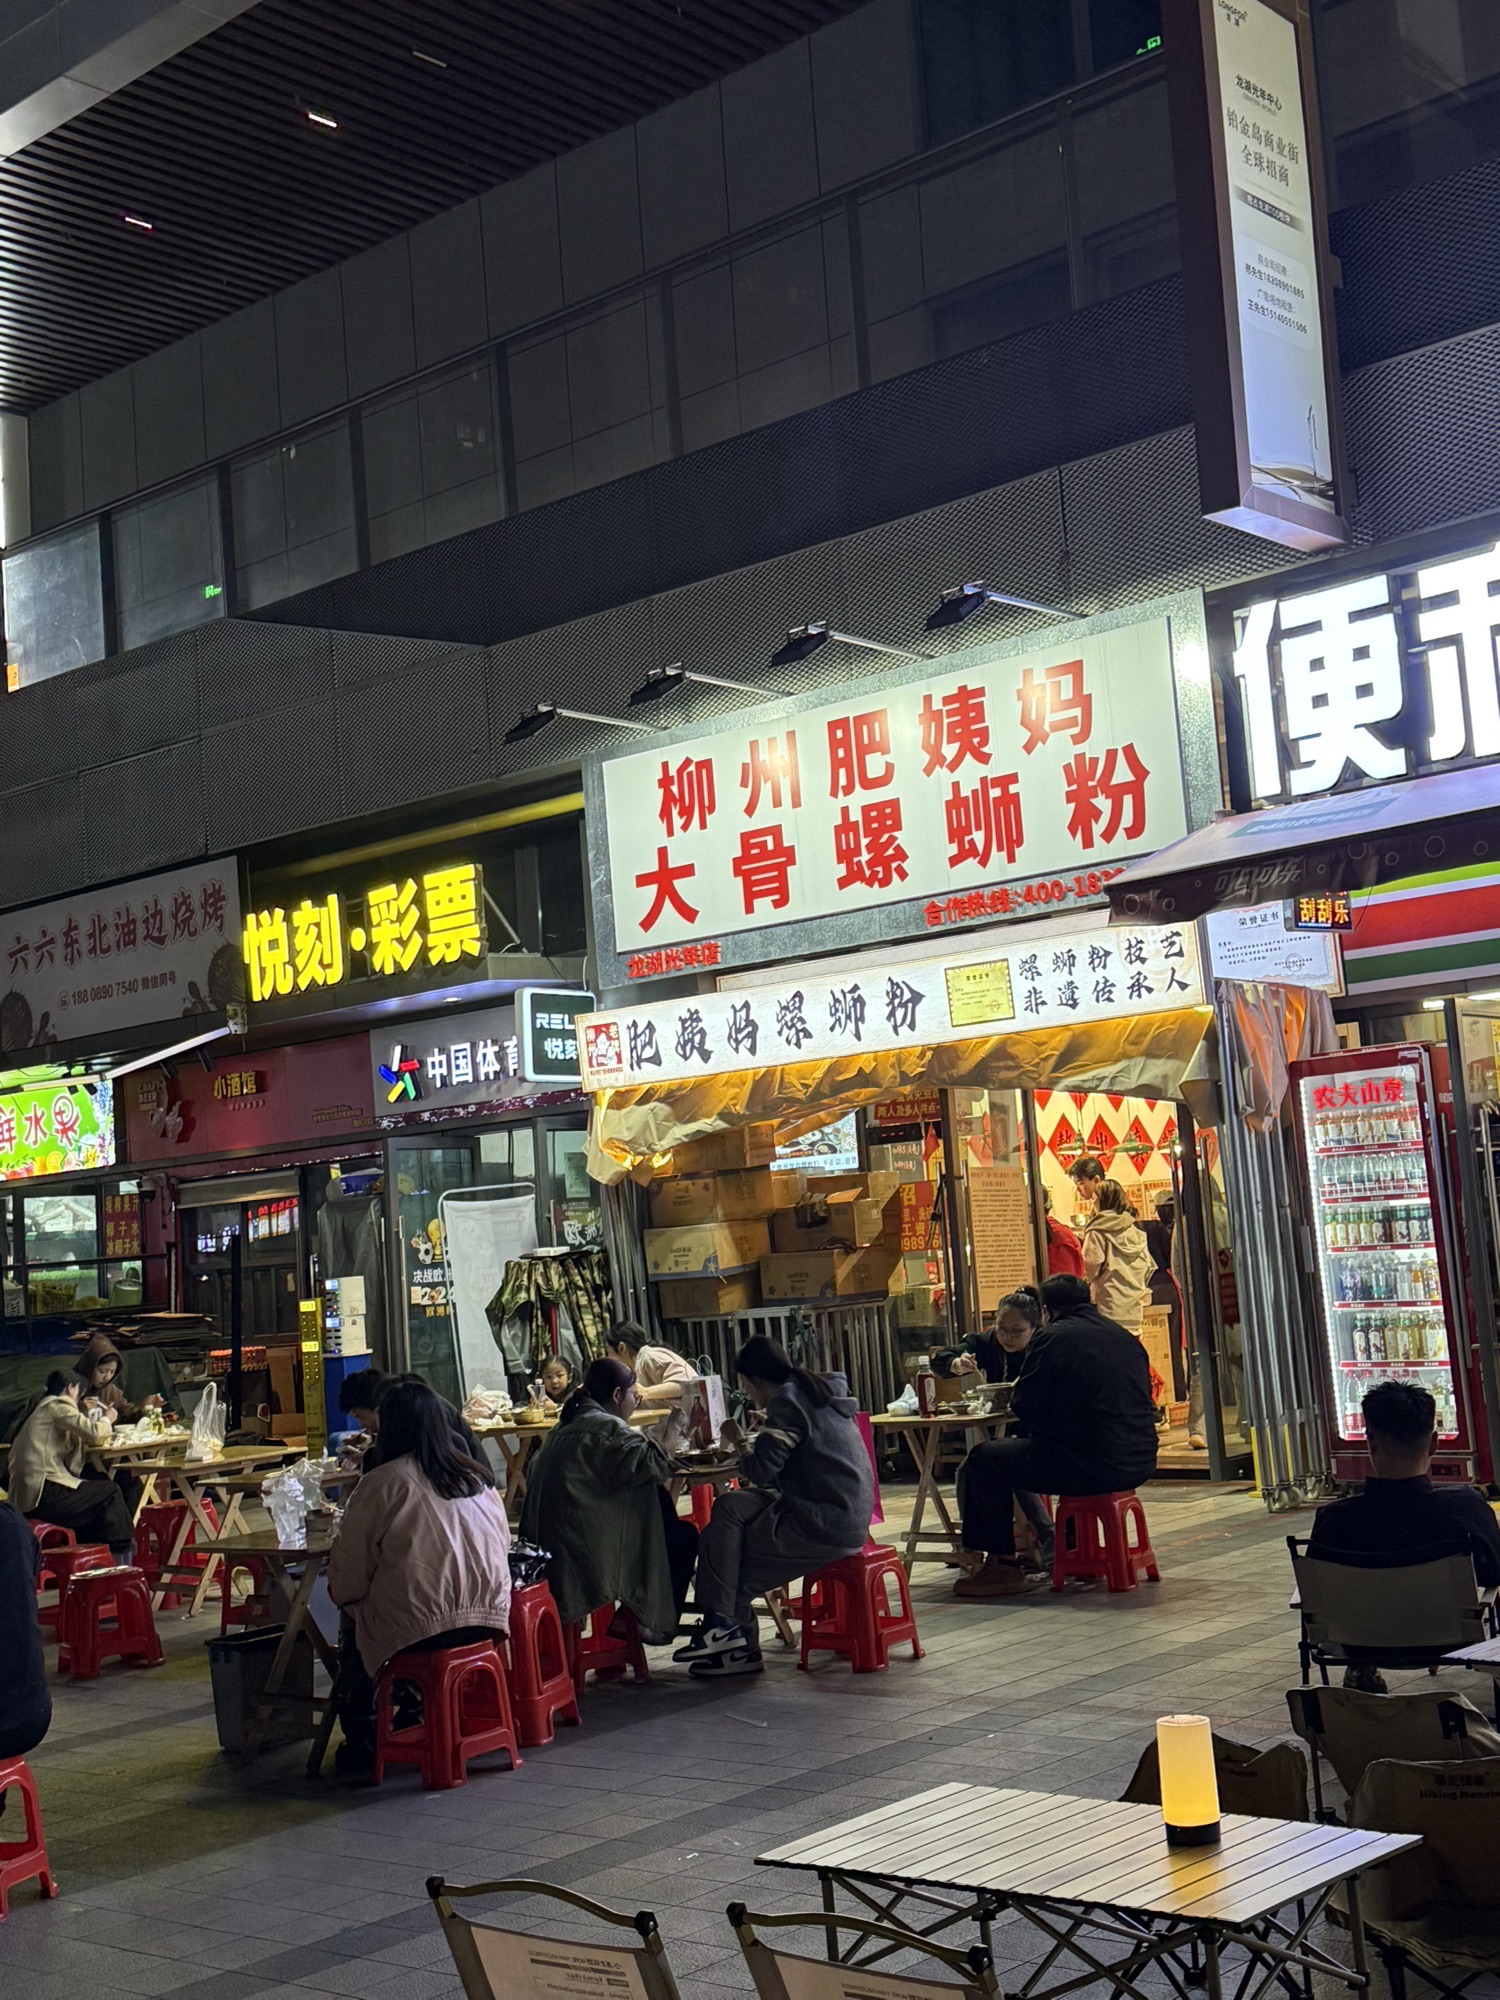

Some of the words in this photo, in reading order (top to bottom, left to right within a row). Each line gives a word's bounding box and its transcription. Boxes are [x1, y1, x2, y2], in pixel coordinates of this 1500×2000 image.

[1235, 74, 1282, 111] 龙湖光年中心
[1227, 107, 1299, 165] 铂金岛商业街
[1241, 144, 1289, 187] 全球招商
[657, 659, 1093, 838] 柳州肥姨妈
[635, 742, 1151, 934] 大骨螺蛳粉
[8, 881, 227, 976] 六六东北油边烧烤
[243, 863, 482, 1002] 悦刻·彩票
[1238, 911, 1279, 926] 荣誉证书
[1299, 898, 1349, 924] 刮刮乐
[627, 941, 721, 978] 龙湖光年店
[1018, 931, 1184, 981] 螺蛳粉技艺
[71, 991, 88, 1005] 188
[90, 985, 113, 1001] 0890
[115, 979, 139, 997] 7540
[141, 971, 177, 991] 微信同号
[1023, 967, 1192, 1015] 非遗传承人
[626, 976, 926, 1072] 肥姨妈螺蛳粉
[213, 1071, 256, 1099] 小酒馆
[1312, 1077, 1405, 1110] 农夫山泉
